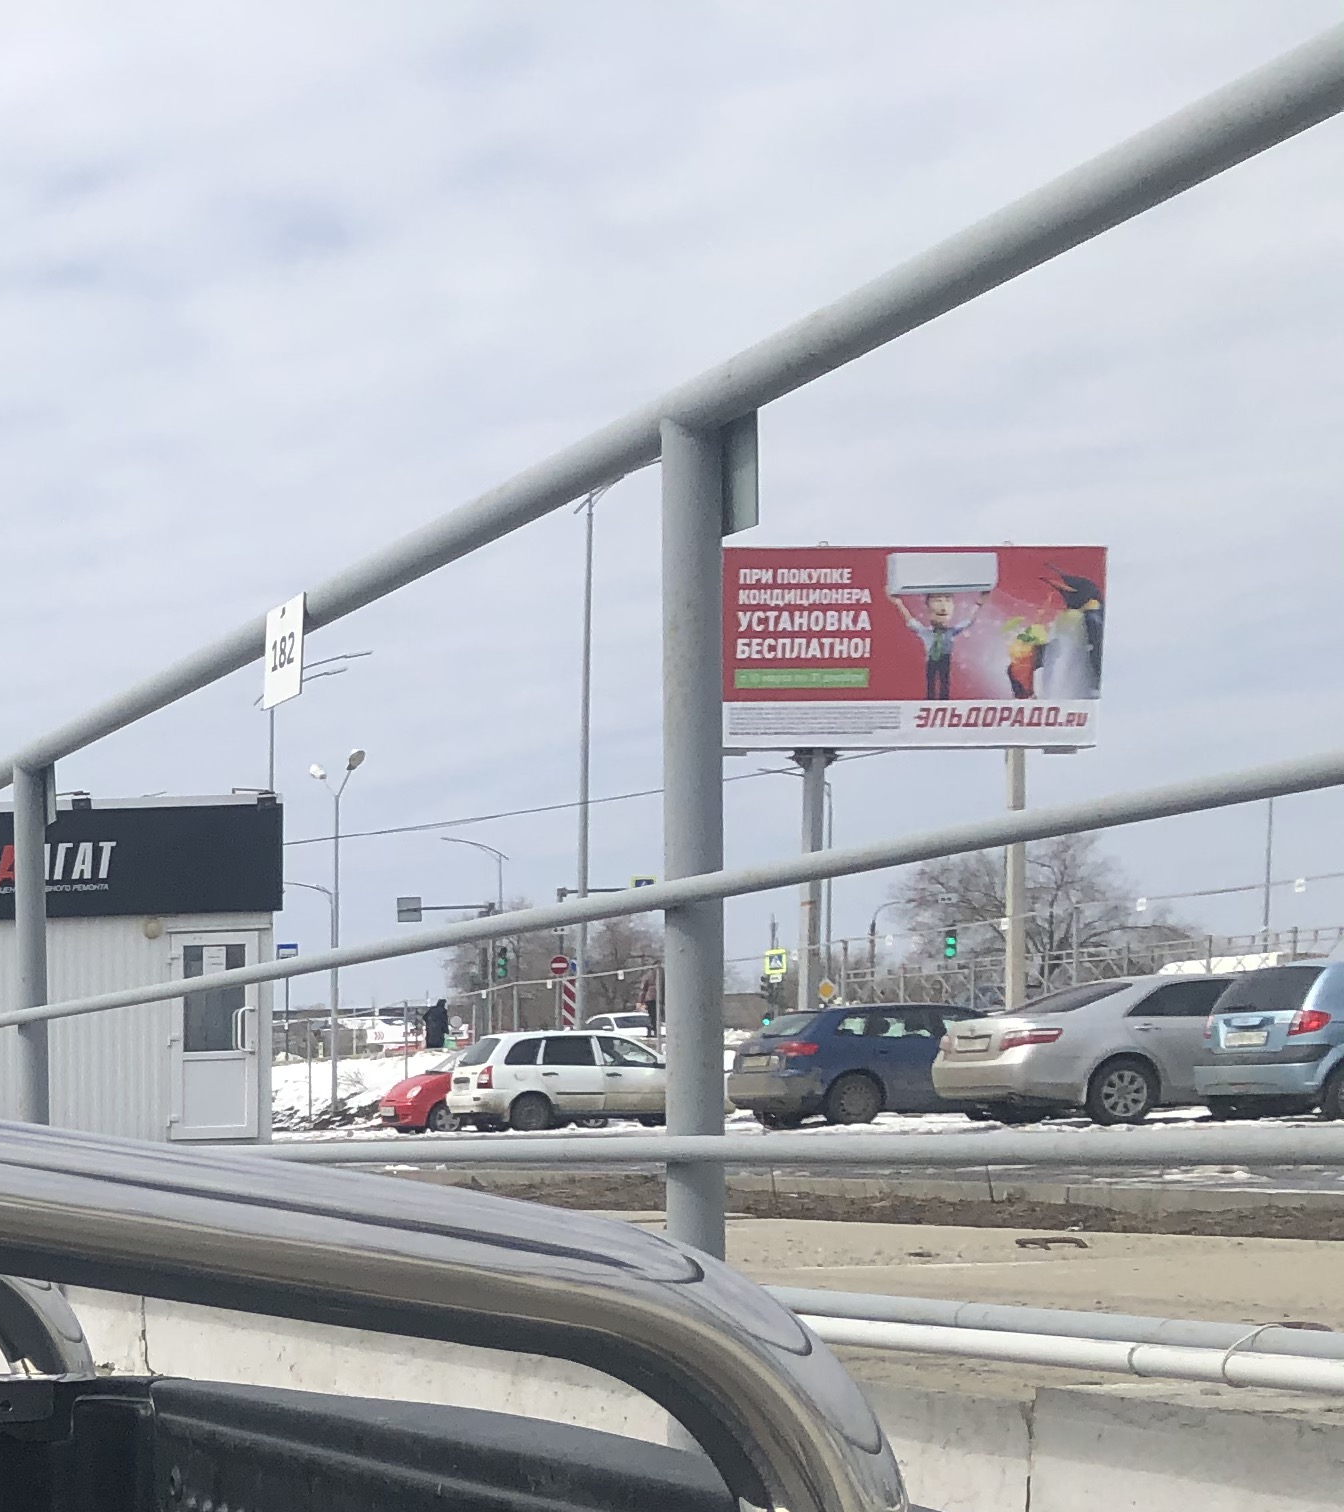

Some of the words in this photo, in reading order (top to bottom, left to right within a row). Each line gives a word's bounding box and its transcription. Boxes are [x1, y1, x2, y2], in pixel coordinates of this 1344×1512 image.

[738, 568, 773, 584] ПРИ
[776, 568, 852, 584] ПОКУПКЕ
[737, 588, 872, 607] КОНДИЦИОНЕРА
[736, 610, 872, 632] УСТАНОВКА
[271, 631, 295, 673] 182
[735, 637, 872, 660] БЕСПЛАТНО!
